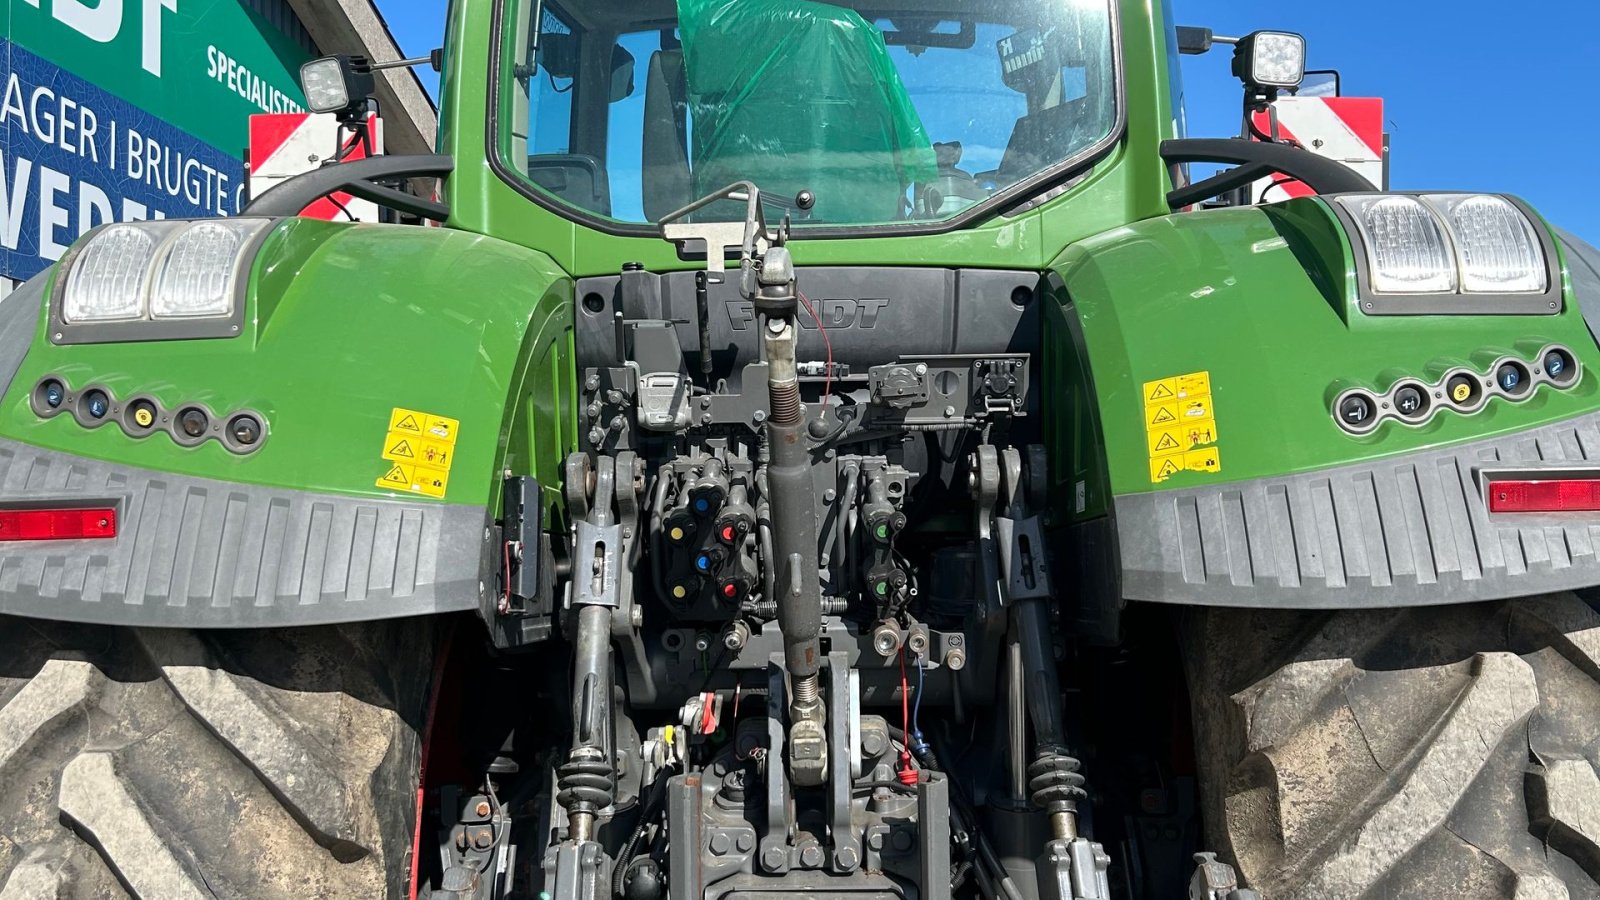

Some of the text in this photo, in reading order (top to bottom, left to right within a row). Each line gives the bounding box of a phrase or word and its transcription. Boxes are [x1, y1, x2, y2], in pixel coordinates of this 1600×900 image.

[207, 44, 306, 114] SPECIALIST
[110, 120, 116, 170] I
[127, 129, 229, 217] BRUGTE
[725, 298, 890, 330] FNDT
